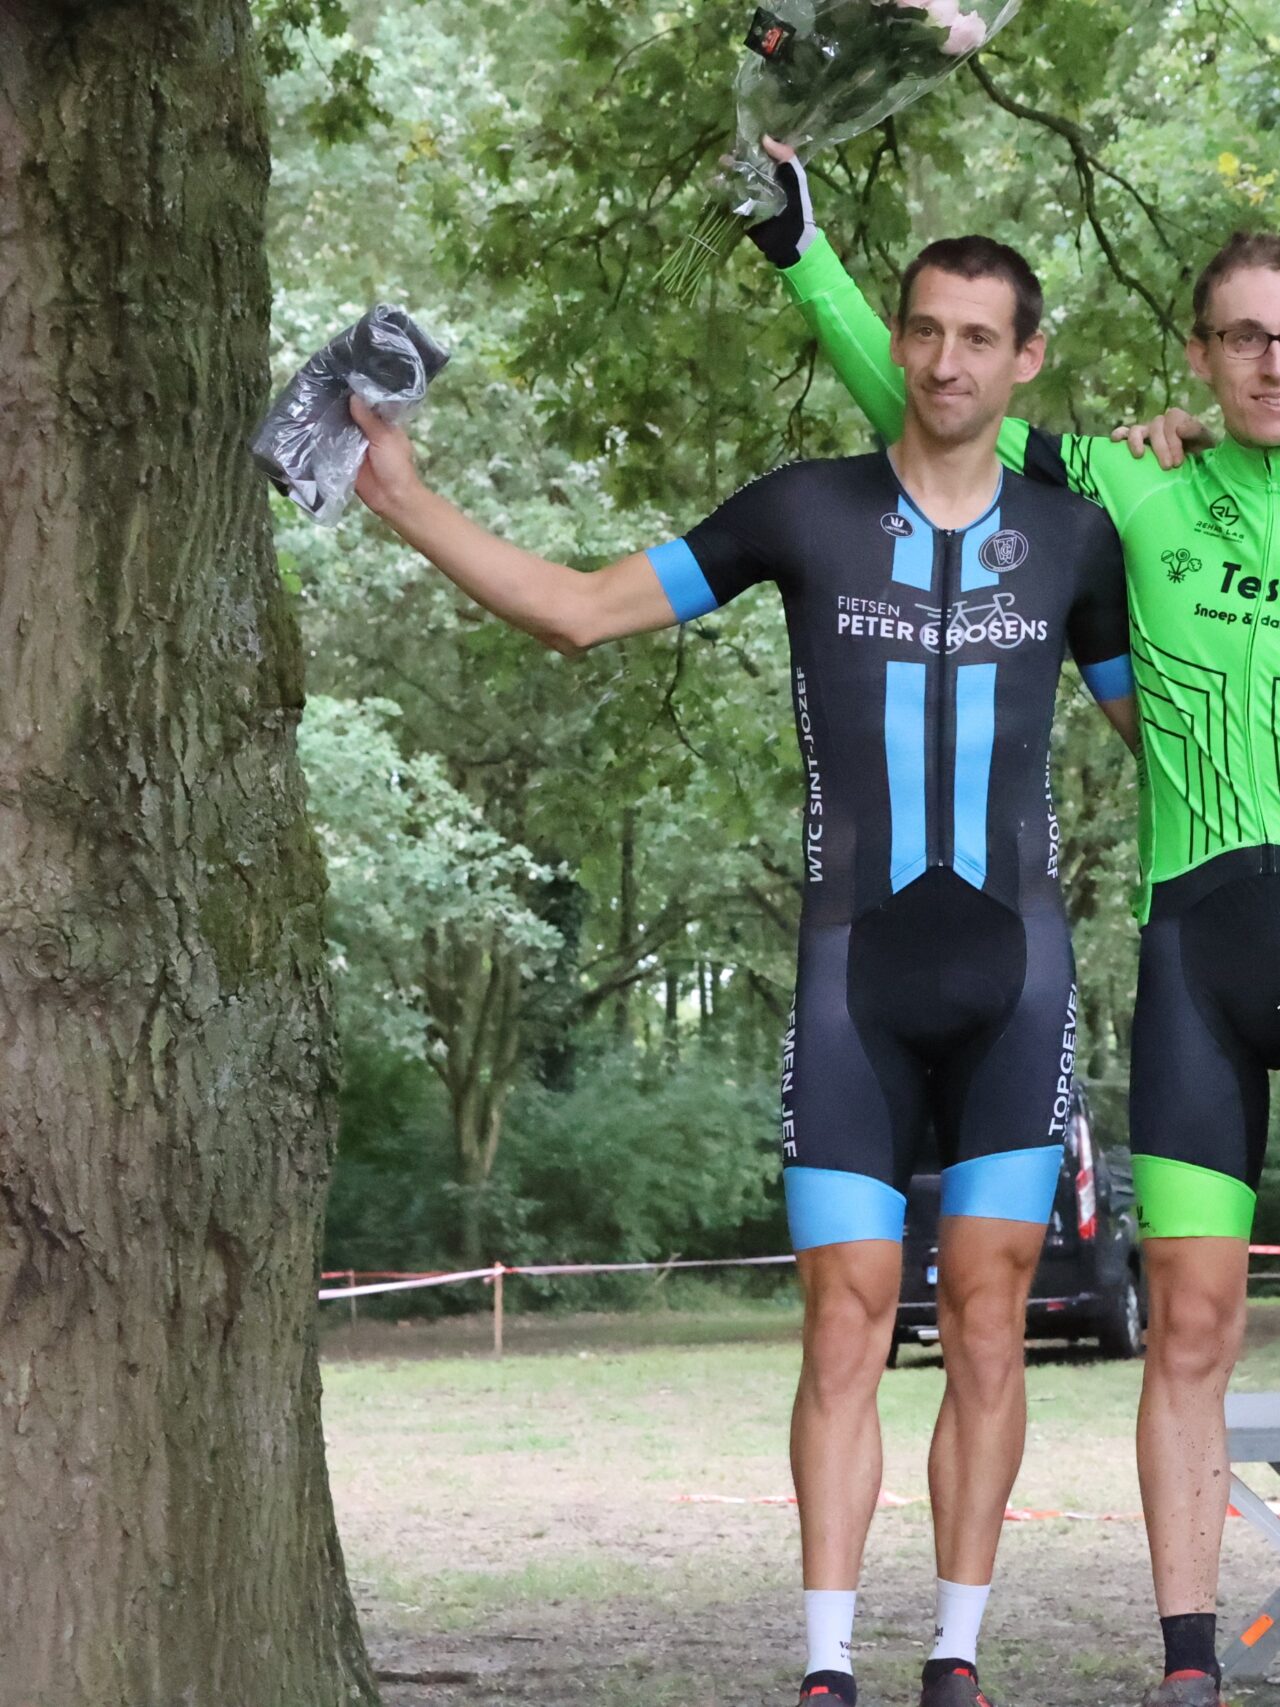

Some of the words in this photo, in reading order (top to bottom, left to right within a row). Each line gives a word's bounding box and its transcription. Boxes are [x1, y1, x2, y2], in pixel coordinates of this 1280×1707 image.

[838, 596, 900, 617] FIETSEN
[1194, 603, 1238, 625] Snoep
[1242, 612, 1252, 624] &
[837, 614, 914, 641] PETER
[796, 667, 822, 816] SINT-JOZEF
[807, 823, 823, 882] WTC
[782, 1103, 798, 1158] JEF
